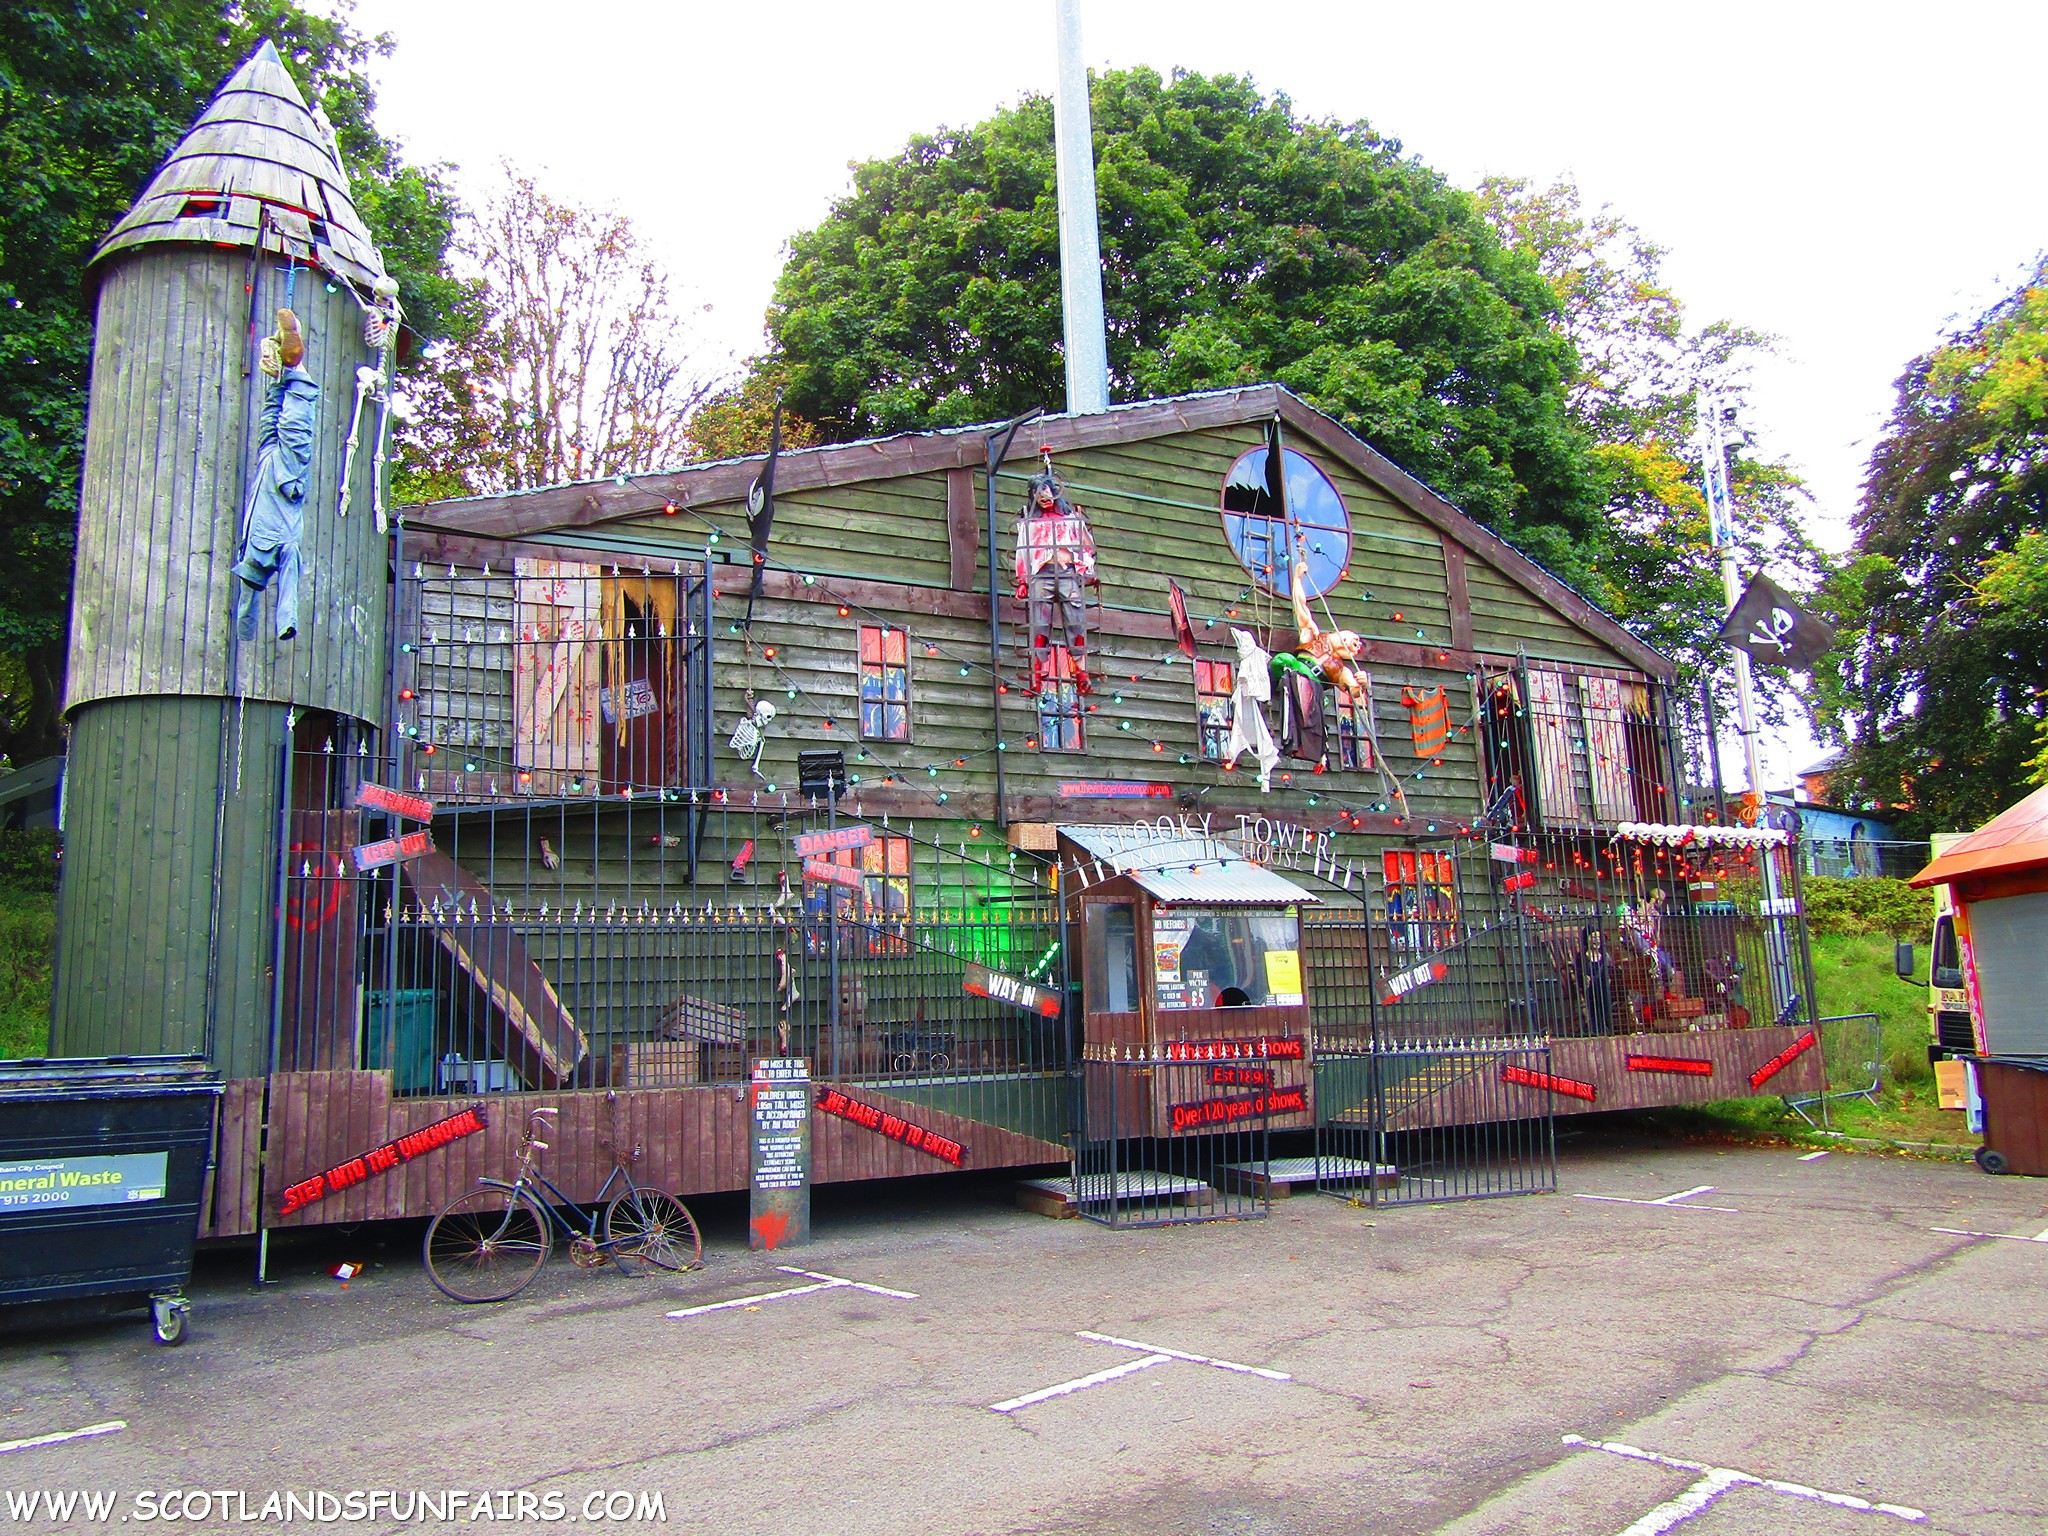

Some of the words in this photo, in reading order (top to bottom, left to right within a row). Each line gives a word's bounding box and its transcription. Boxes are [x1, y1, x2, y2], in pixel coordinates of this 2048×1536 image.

[362, 784, 433, 821] WARNING
[361, 841, 397, 865] KEEP
[400, 832, 427, 855] OUT
[800, 827, 872, 852] DANGER
[1100, 813, 1212, 853] SPOOKY
[1235, 814, 1331, 862] TOWER
[1242, 842, 1302, 870] HOUSE
[808, 862, 837, 882] KEEP
[839, 867, 860, 886] OUT
[1154, 920, 1162, 929] NO
[1163, 920, 1185, 929] REFUNDS
[988, 973, 1020, 1002] WAY
[1021, 985, 1036, 1007] IN
[1388, 971, 1413, 996] WAY
[1413, 962, 1431, 985] OUT
[1192, 988, 1205, 1007] £5
[755, 1070, 767, 1079] TALL
[768, 1070, 775, 1078] TO
[776, 1069, 791, 1078] ENTER
[793, 1069, 808, 1078] ALONE
[760, 1060, 769, 1069] YOU
[770, 1060, 784, 1069] MUST
[785, 1060, 792, 1068] BE
[794, 1059, 804, 1068] THIS
[1213, 1067, 1235, 1083] Est
[1507, 1065, 1529, 1084] ENTER
[1539, 1073, 1558, 1090] YOR
[1576, 1081, 1595, 1100] RISK
[758, 1091, 785, 1100] CHILDREN
[786, 1091, 805, 1099] UNDER
[774, 1101, 788, 1109] TALL
[790, 1101, 805, 1109] MUST
[757, 1111, 764, 1120] BE
[766, 1110, 806, 1119] ACCOMPANIED
[1174, 1107, 1201, 1127] Over
[1203, 1100, 1224, 1120] 120
[1255, 1095, 1265, 1113] o
[1268, 1091, 1301, 1110] shows
[762, 1121, 771, 1130] BY
[772, 1121, 780, 1129] AN
[782, 1120, 800, 1129] ADULT
[826, 1091, 847, 1113] WE
[846, 1100, 881, 1128] DARE
[880, 1113, 906, 1140] YOU
[906, 1124, 923, 1145] TO
[923, 1132, 961, 1162] ENTER
[0, 1165, 16, 1173] ham
[18, 1164, 34, 1173] City
[35, 1163, 64, 1172] Council
[283, 1175, 325, 1208] STEP
[326, 1158, 367, 1191] INTO
[365, 1144, 399, 1175] THE
[397, 1109, 479, 1162] UNKNOWN
[0, 1171, 55, 1192] neral
[60, 1170, 122, 1187] Waste
[4, 1194, 29, 1206] 915
[32, 1191, 70, 1204] 2000
